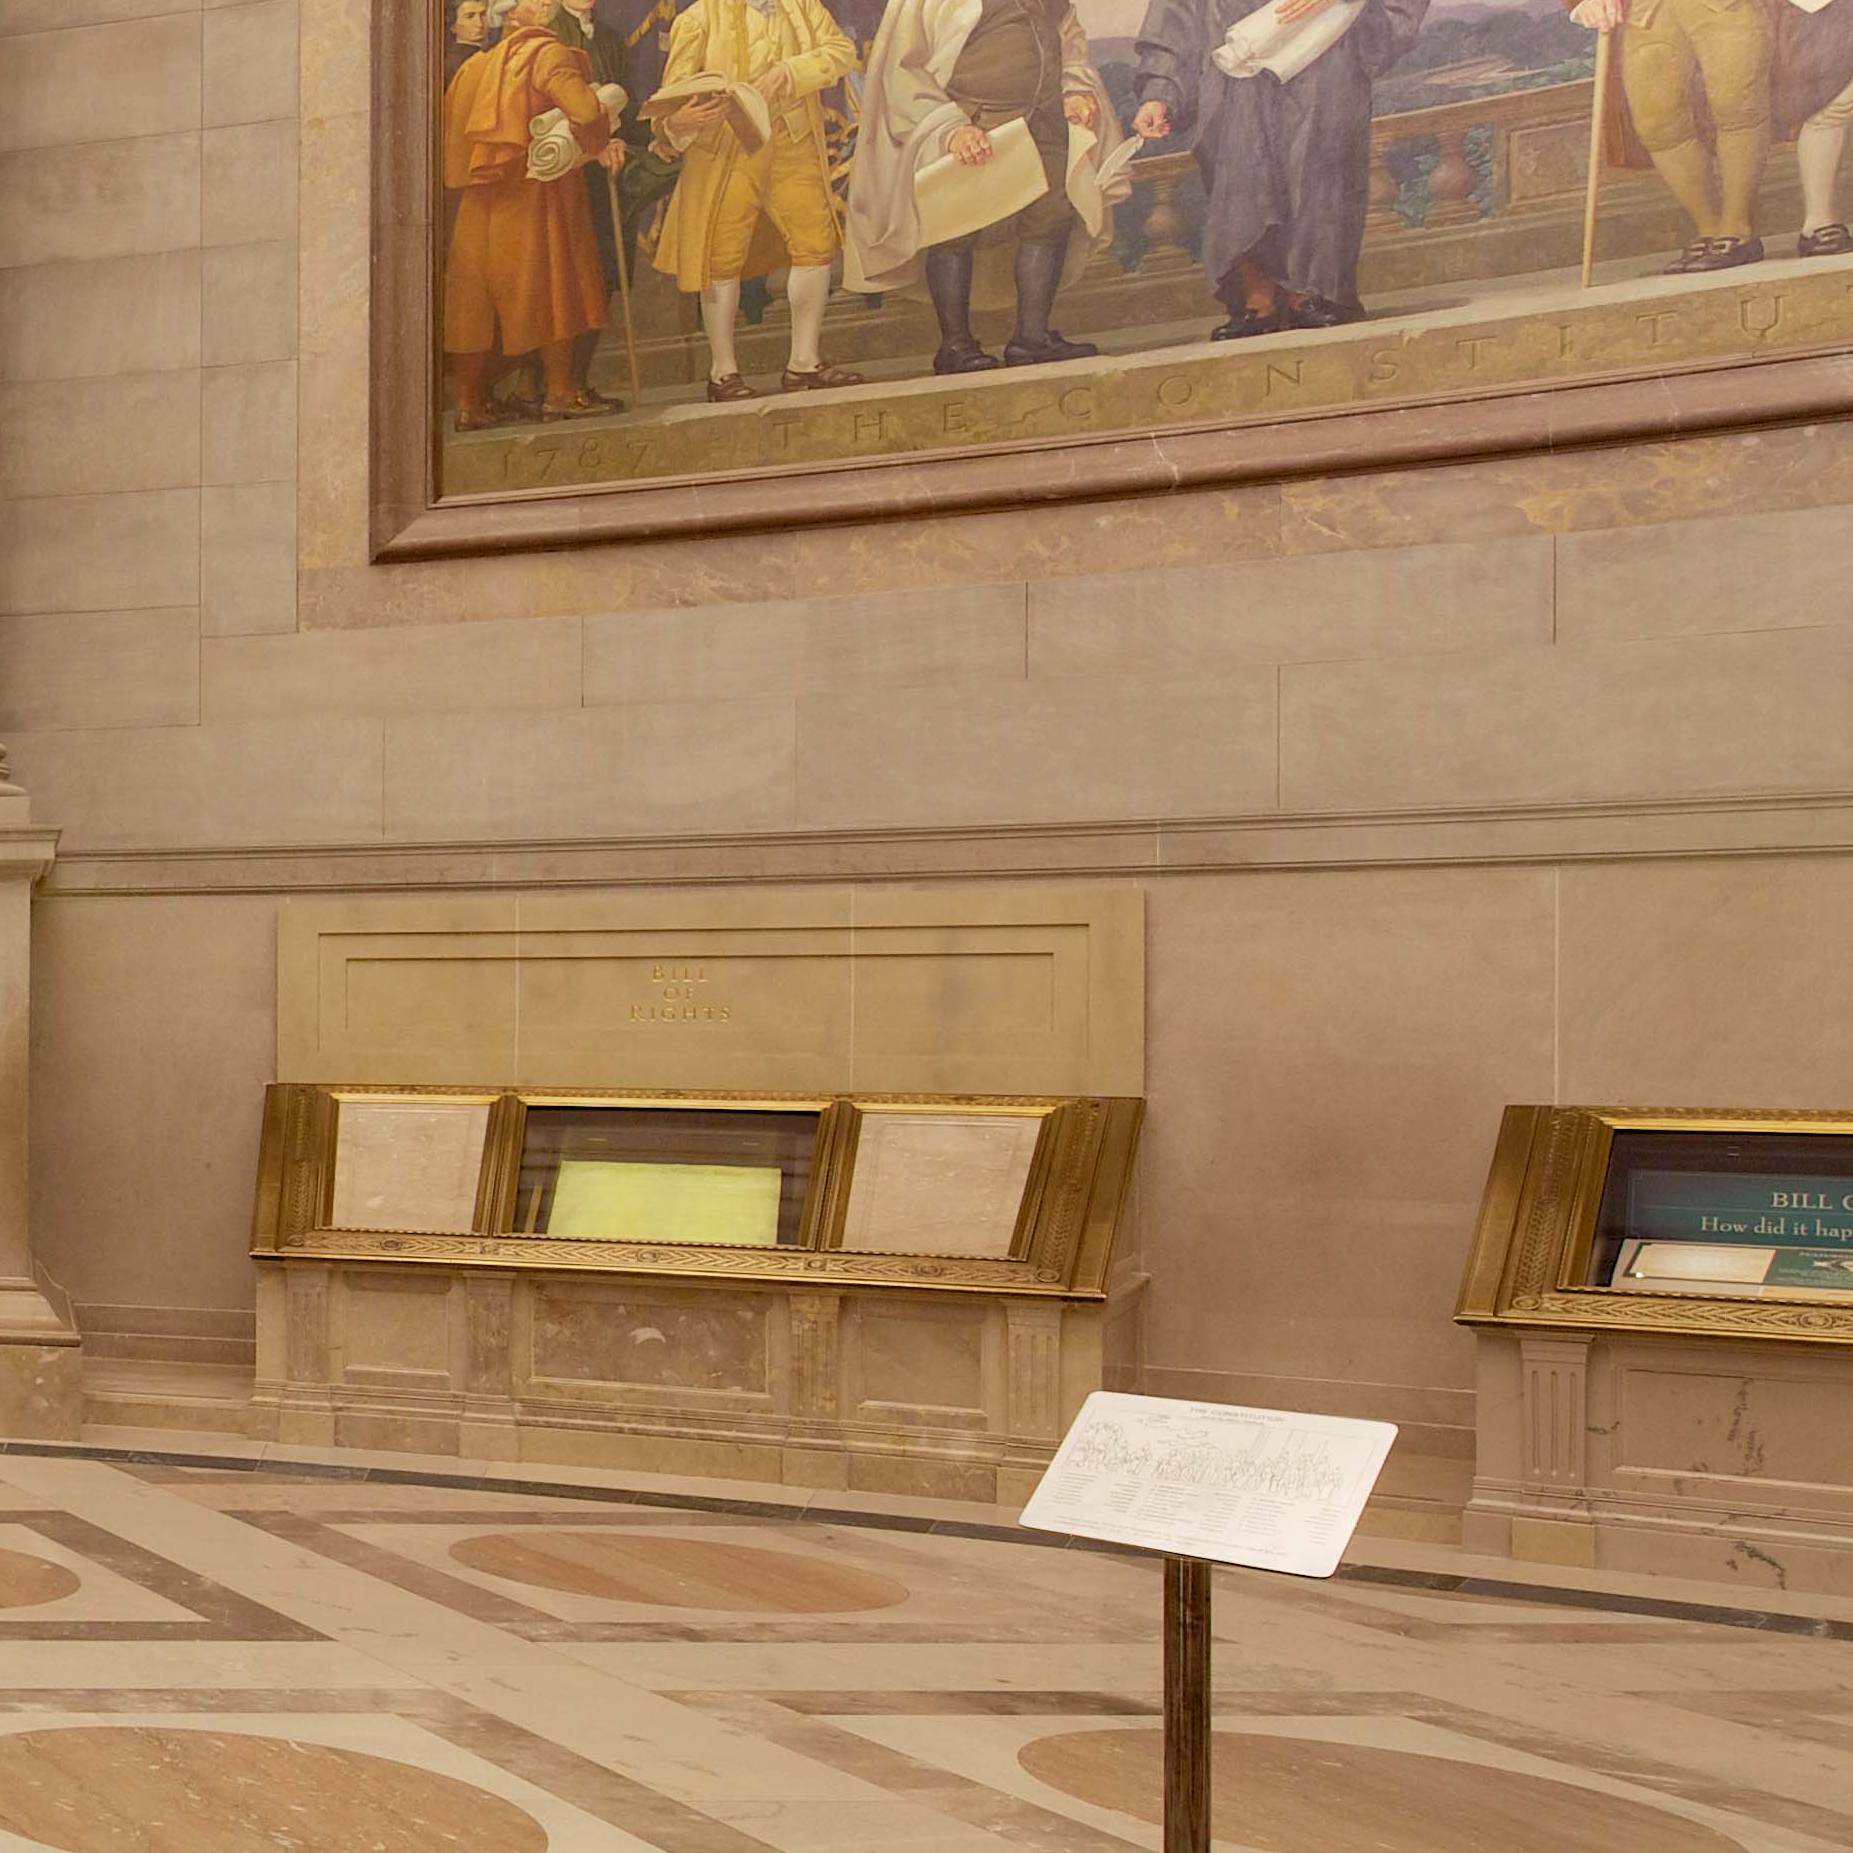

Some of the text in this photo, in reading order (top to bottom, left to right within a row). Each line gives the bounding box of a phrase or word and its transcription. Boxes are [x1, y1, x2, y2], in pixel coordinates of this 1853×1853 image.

[501, 283, 1853, 479] 1787 THE CONSTITU
[653, 964, 710, 983] BILL
[663, 986, 694, 1002] OF
[629, 1004, 732, 1022] RIGHTS
[1772, 1191, 1833, 1210] BILL
[1701, 1216, 1748, 1233] How
[1753, 1217, 1785, 1235] did
[1793, 1221, 1808, 1236] it
